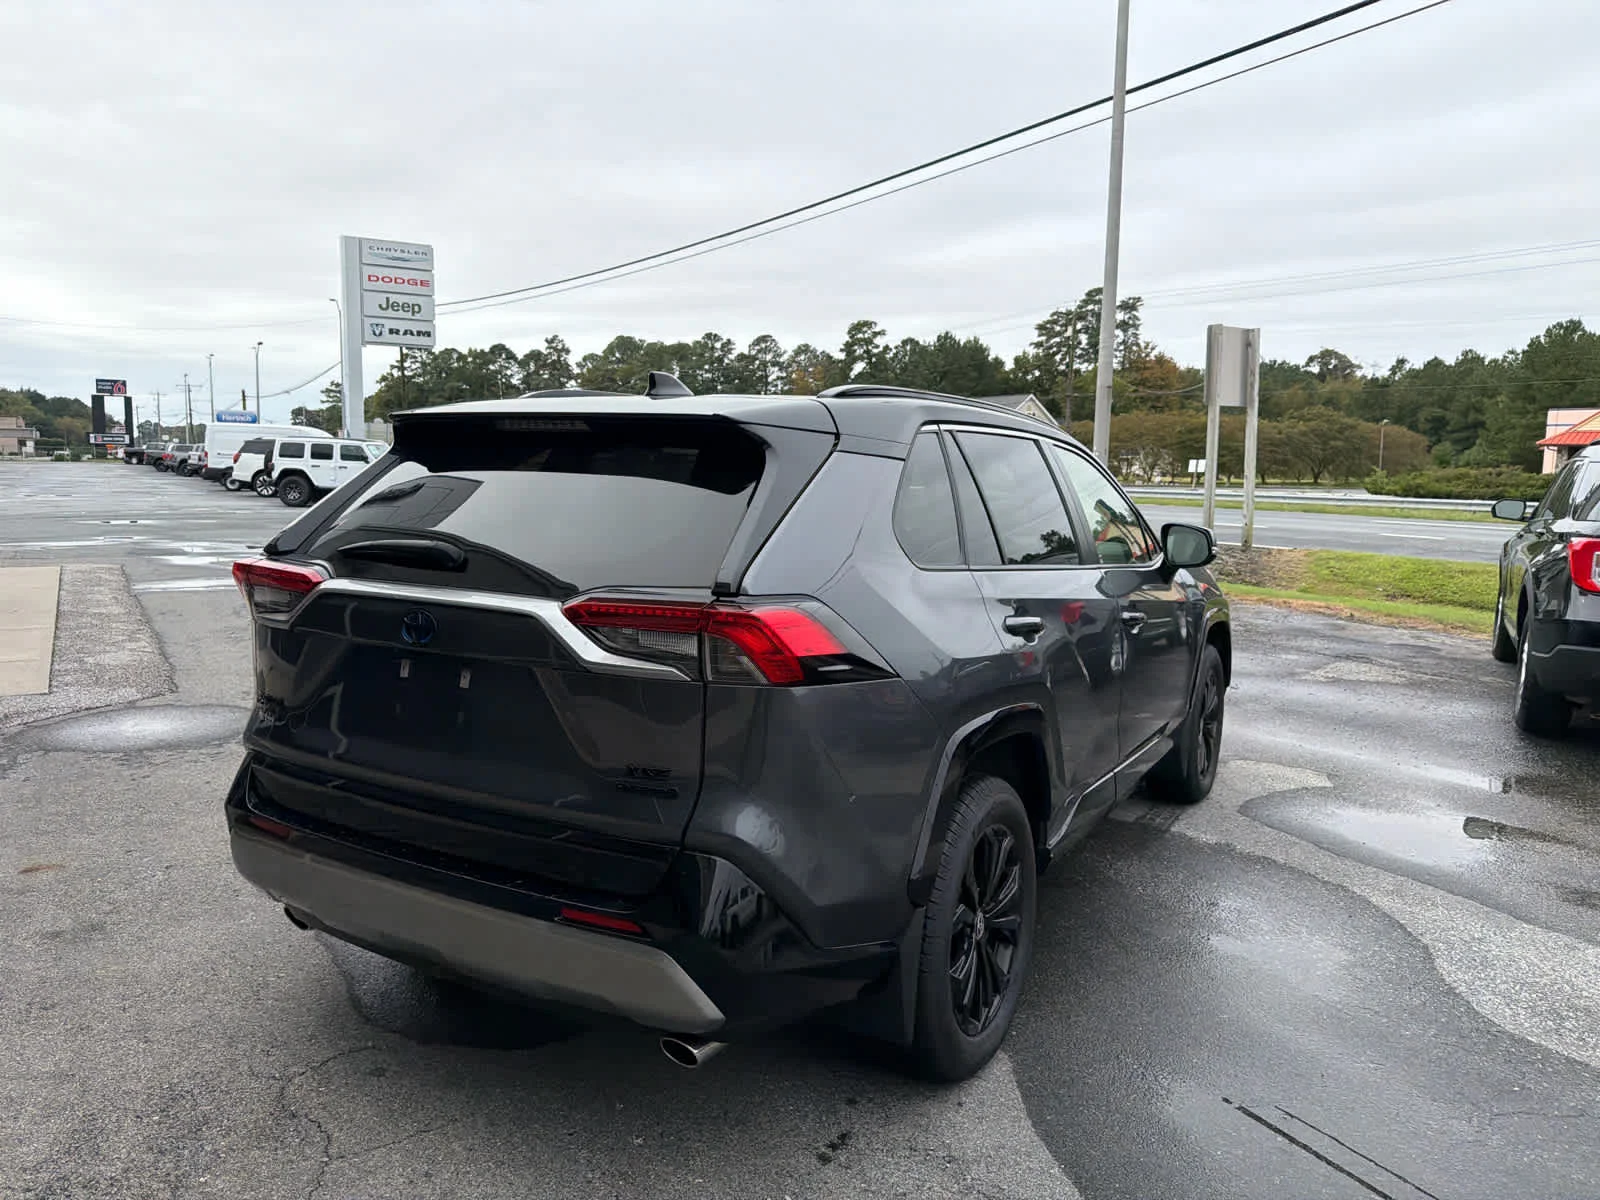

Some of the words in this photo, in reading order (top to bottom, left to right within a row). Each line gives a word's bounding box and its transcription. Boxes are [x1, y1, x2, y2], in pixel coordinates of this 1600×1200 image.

[367, 274, 431, 288] DODGE
[378, 296, 422, 317] Jeep
[388, 328, 432, 338] RAM
